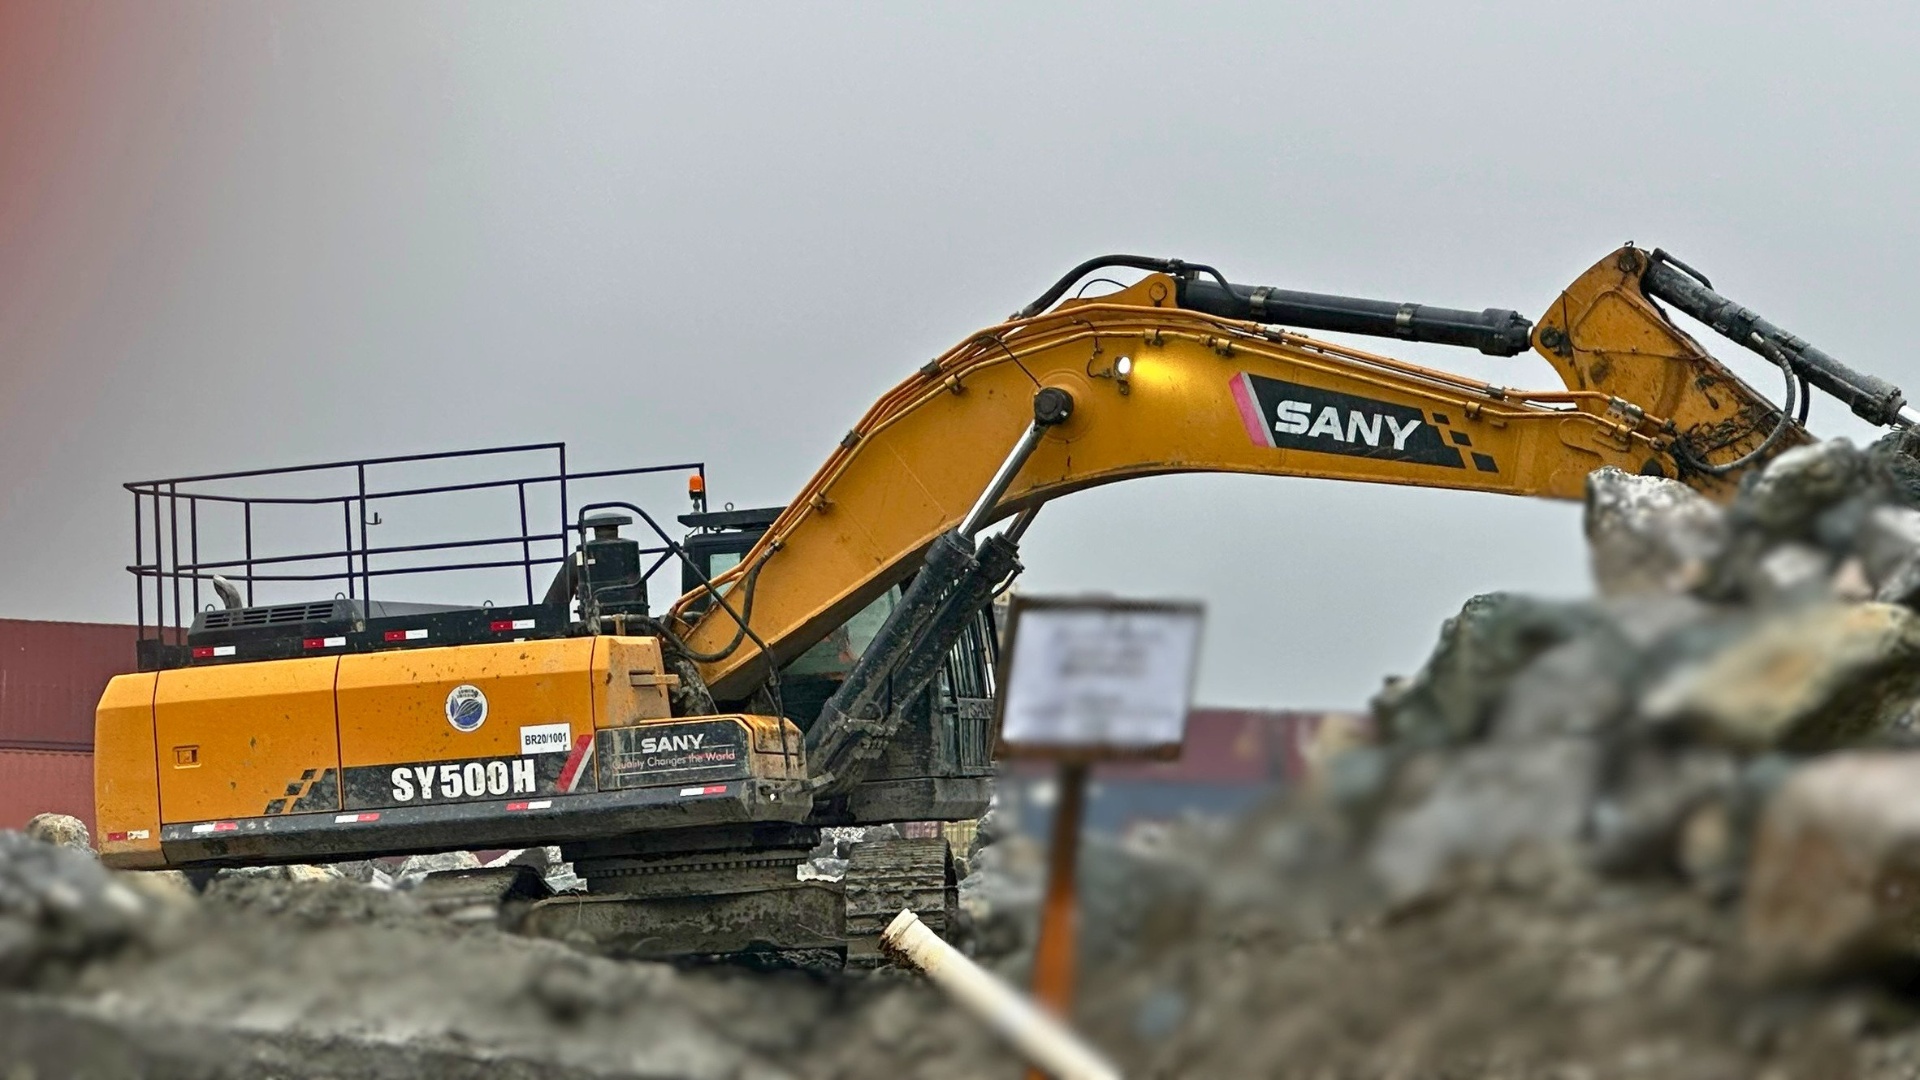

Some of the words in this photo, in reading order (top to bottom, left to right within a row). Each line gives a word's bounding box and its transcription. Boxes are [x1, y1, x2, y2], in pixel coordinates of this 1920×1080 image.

[1275, 400, 1422, 450] SANY
[525, 732, 567, 746] BR20/1001
[641, 733, 704, 754] SANY
[612, 760, 645, 771] Quality
[647, 755, 686, 767] Changes
[688, 753, 703, 763] the
[705, 749, 735, 761] World
[391, 759, 536, 801] SY500H
